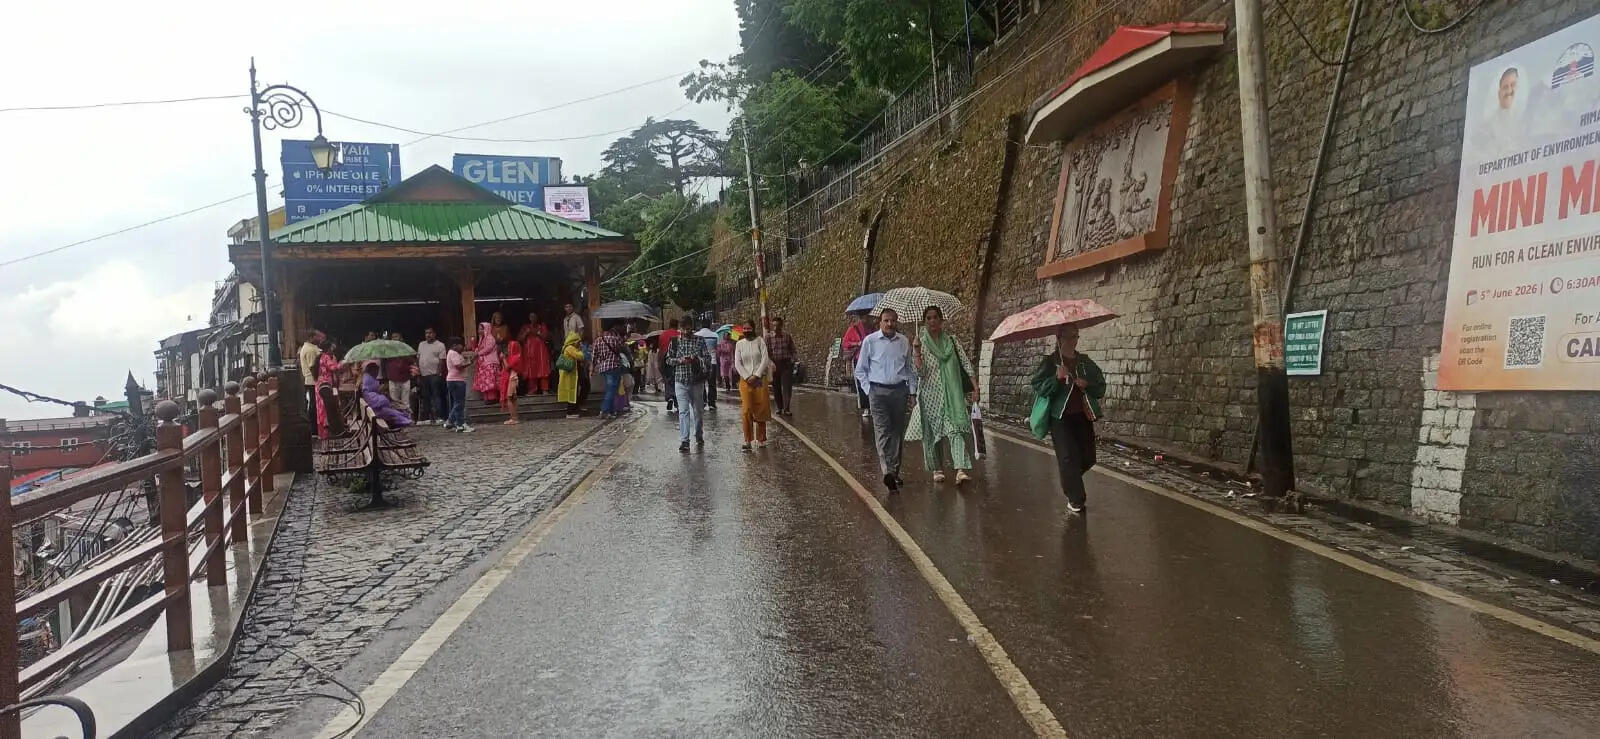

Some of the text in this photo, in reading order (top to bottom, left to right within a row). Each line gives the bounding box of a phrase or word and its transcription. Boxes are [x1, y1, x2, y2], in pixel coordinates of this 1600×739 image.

[462, 159, 540, 184] GLEN
[1478, 151, 1529, 175] DEPARTMENT
[1531, 148, 1542, 161] OF
[306, 184, 380, 194] 0% INTEREST
[1470, 160, 1600, 237] MINI M
[1472, 255, 1493, 270] RUN
[1495, 250, 1515, 266] FOR
[1517, 248, 1525, 262] A
[1527, 241, 1563, 261] CLEAN
[1493, 288, 1513, 299] June
[1514, 283, 1538, 297] 2026
[1575, 313, 1594, 326] For
[1467, 358, 1483, 366] Code
